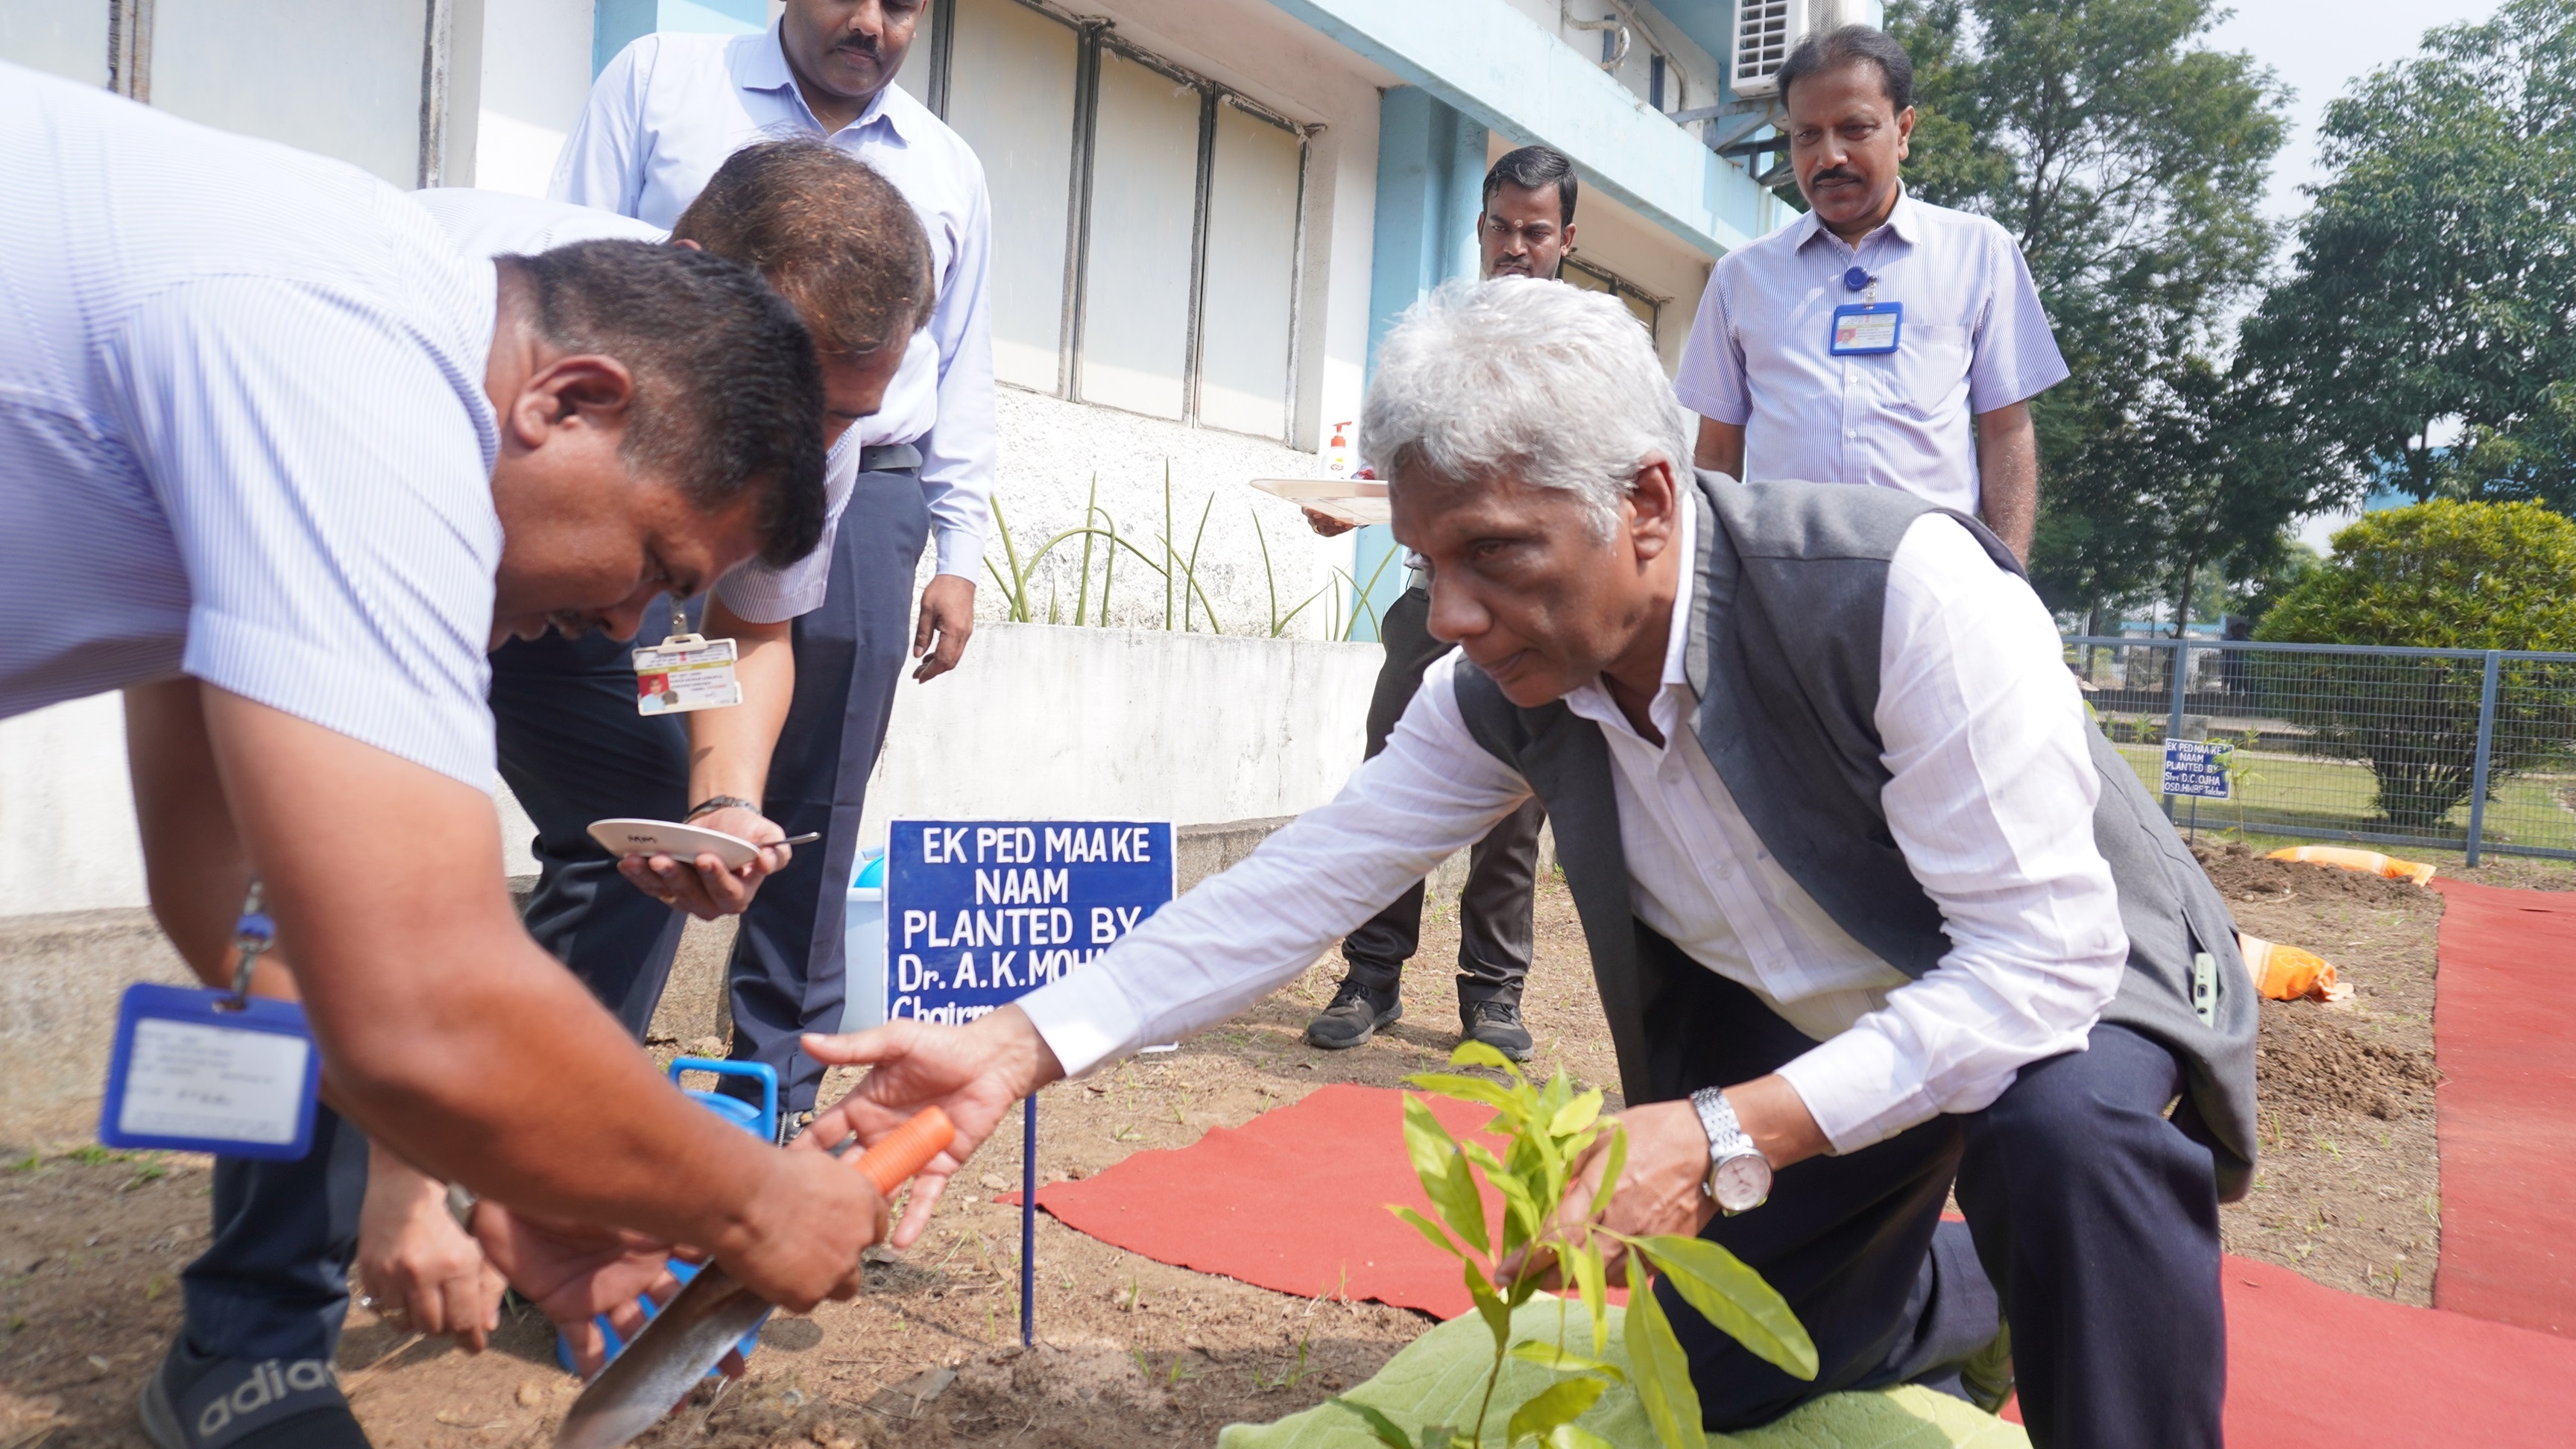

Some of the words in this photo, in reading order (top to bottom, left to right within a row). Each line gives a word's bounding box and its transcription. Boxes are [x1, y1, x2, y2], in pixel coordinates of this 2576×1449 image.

[2168, 742, 2177, 751] EK
[2179, 743, 2194, 753] PED
[2179, 752, 2204, 763] NAAM
[2166, 761, 2204, 772] PLANTED
[2207, 765, 2218, 773] BY
[923, 827, 969, 864] EK
[976, 827, 1036, 864] PED
[975, 868, 1069, 905] NAAM
[903, 907, 1073, 950] PLANTED
[1090, 906, 1142, 944] BY
[897, 953, 946, 992] Dr.
